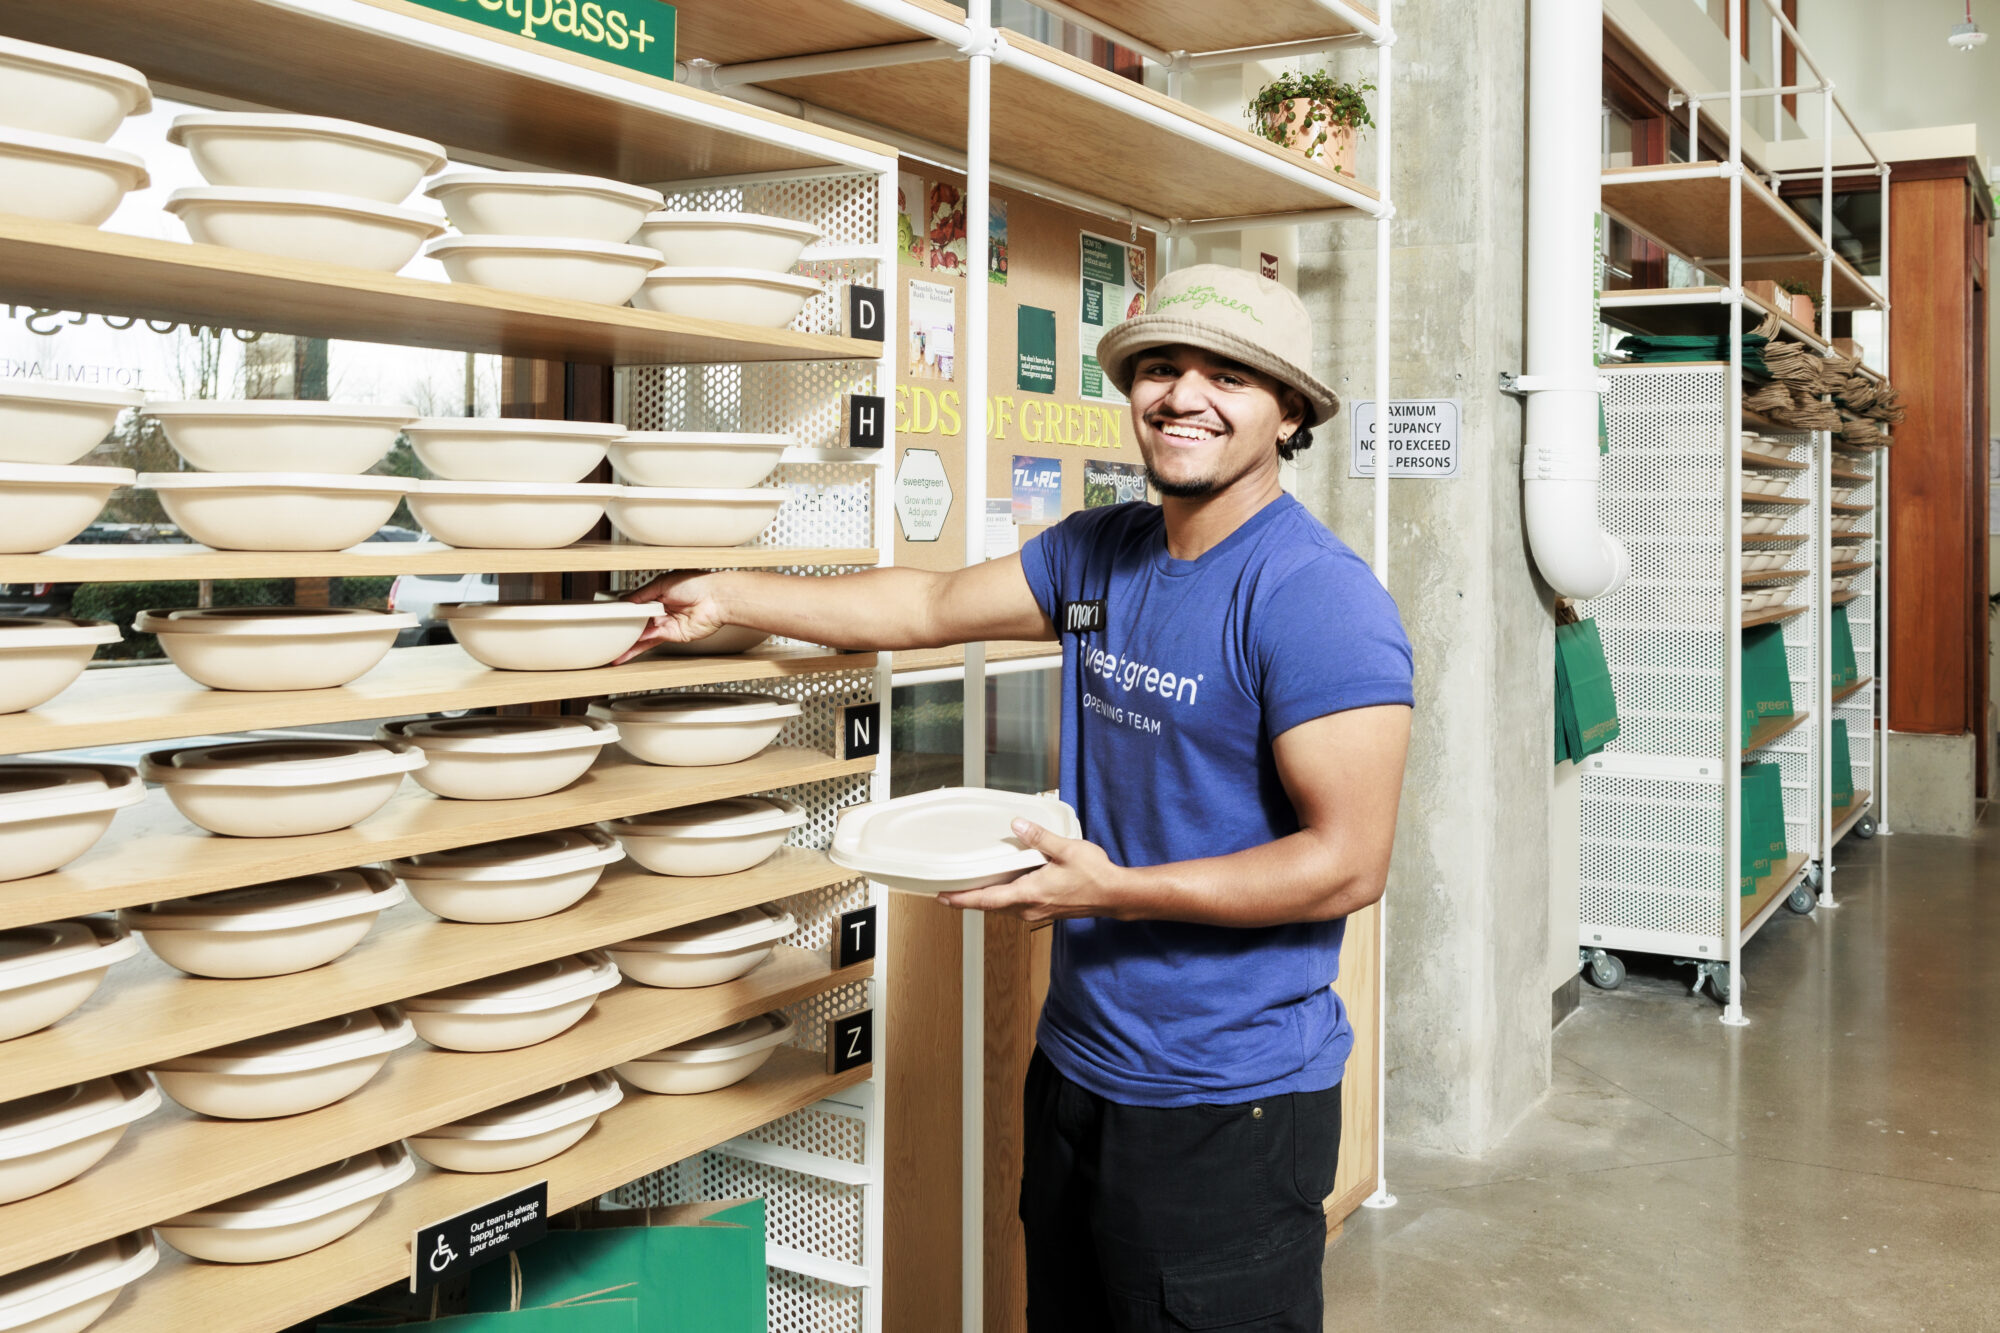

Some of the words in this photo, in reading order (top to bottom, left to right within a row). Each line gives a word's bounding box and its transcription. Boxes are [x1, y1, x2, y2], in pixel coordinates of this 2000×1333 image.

[859, 300, 876, 329] D
[859, 407, 875, 436] H
[1019, 399, 1123, 449] GREEN
[1389, 405, 1436, 417] AXIMUM
[1369, 422, 1442, 434] OCUPANCY
[1388, 440, 1403, 451] TO
[1406, 440, 1451, 451] EXCEED
[1396, 457, 1451, 468] PERSONS
[903, 478, 944, 489] sweetgreen
[1089, 471, 1144, 489] sweetgreen
[904, 495, 920, 505] Grow
[921, 496, 934, 505] with
[908, 506, 920, 516] Add
[1083, 692, 1123, 723] OPENING
[1127, 710, 1161, 736] TEAM
[854, 716, 870, 748] N
[850, 920, 867, 951] T
[847, 1026, 862, 1059] Z
[470, 1221, 486, 1233] Our
[486, 1213, 506, 1227] team
[507, 1209, 514, 1219] is
[514, 1200, 539, 1216] always
[470, 1228, 495, 1244] happy
[495, 1225, 504, 1233] to
[504, 1217, 521, 1230] help
[521, 1211, 538, 1223] with
[469, 1241, 488, 1256] your
[488, 1232, 510, 1247] order.
